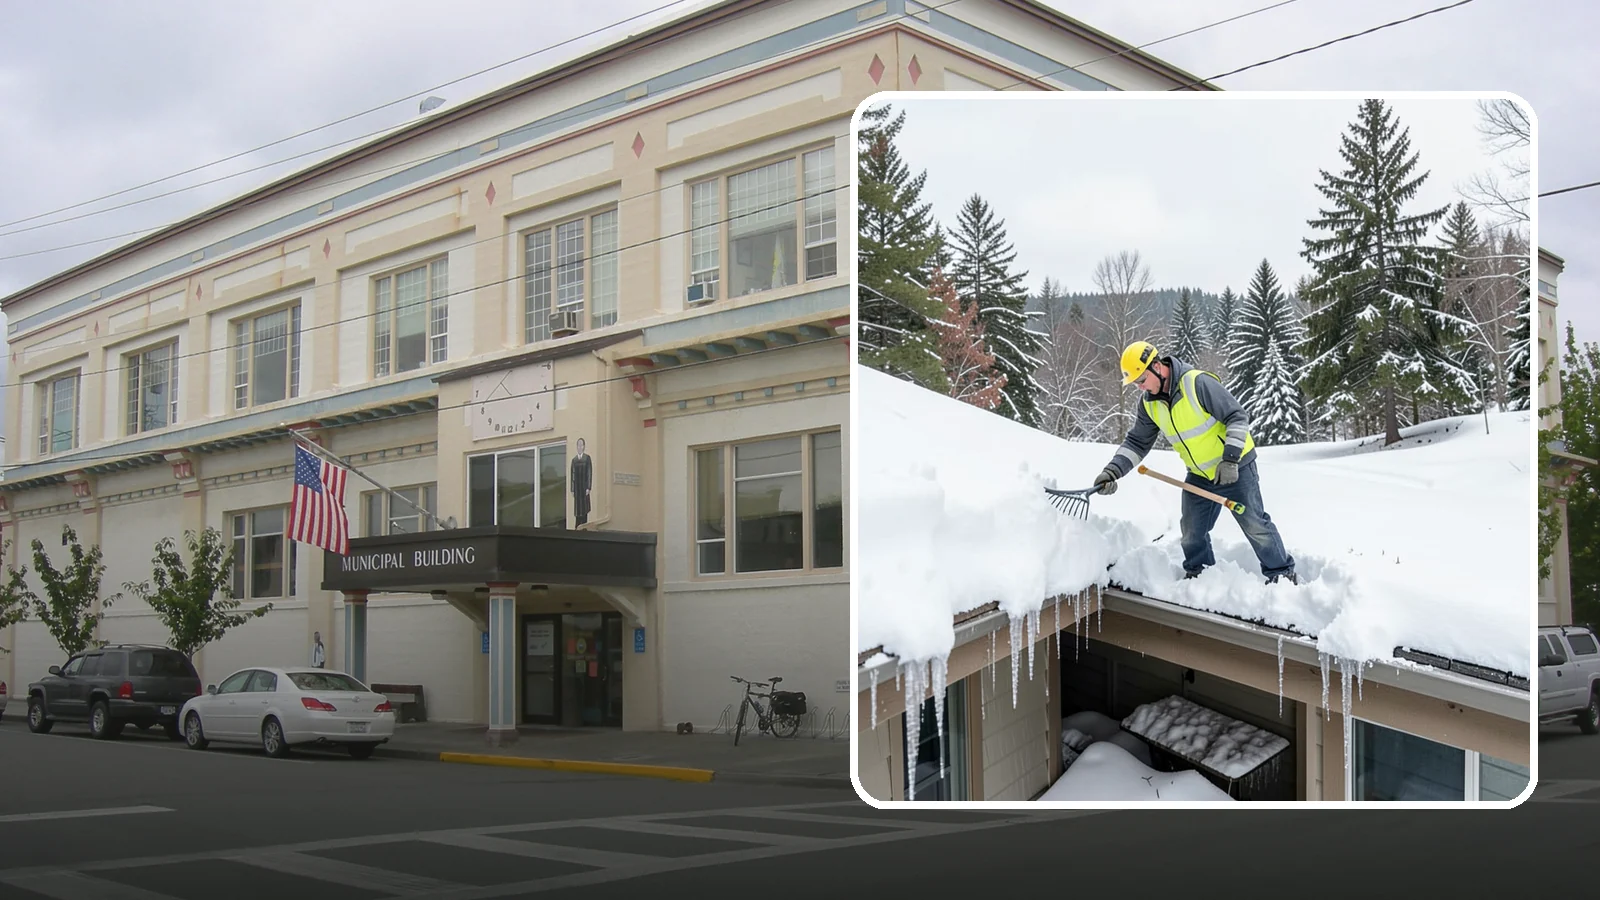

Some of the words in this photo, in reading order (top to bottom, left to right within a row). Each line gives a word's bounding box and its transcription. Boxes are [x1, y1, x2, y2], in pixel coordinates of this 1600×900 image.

[480, 407, 485, 415] 8
[488, 417, 492, 425] 9
[507, 425, 513, 433] 12
[521, 420, 525, 428] 2
[529, 414, 533, 422] 3
[536, 402, 540, 410] 4
[342, 552, 405, 572] MUNICIPAL
[414, 546, 475, 567] BUILDING
